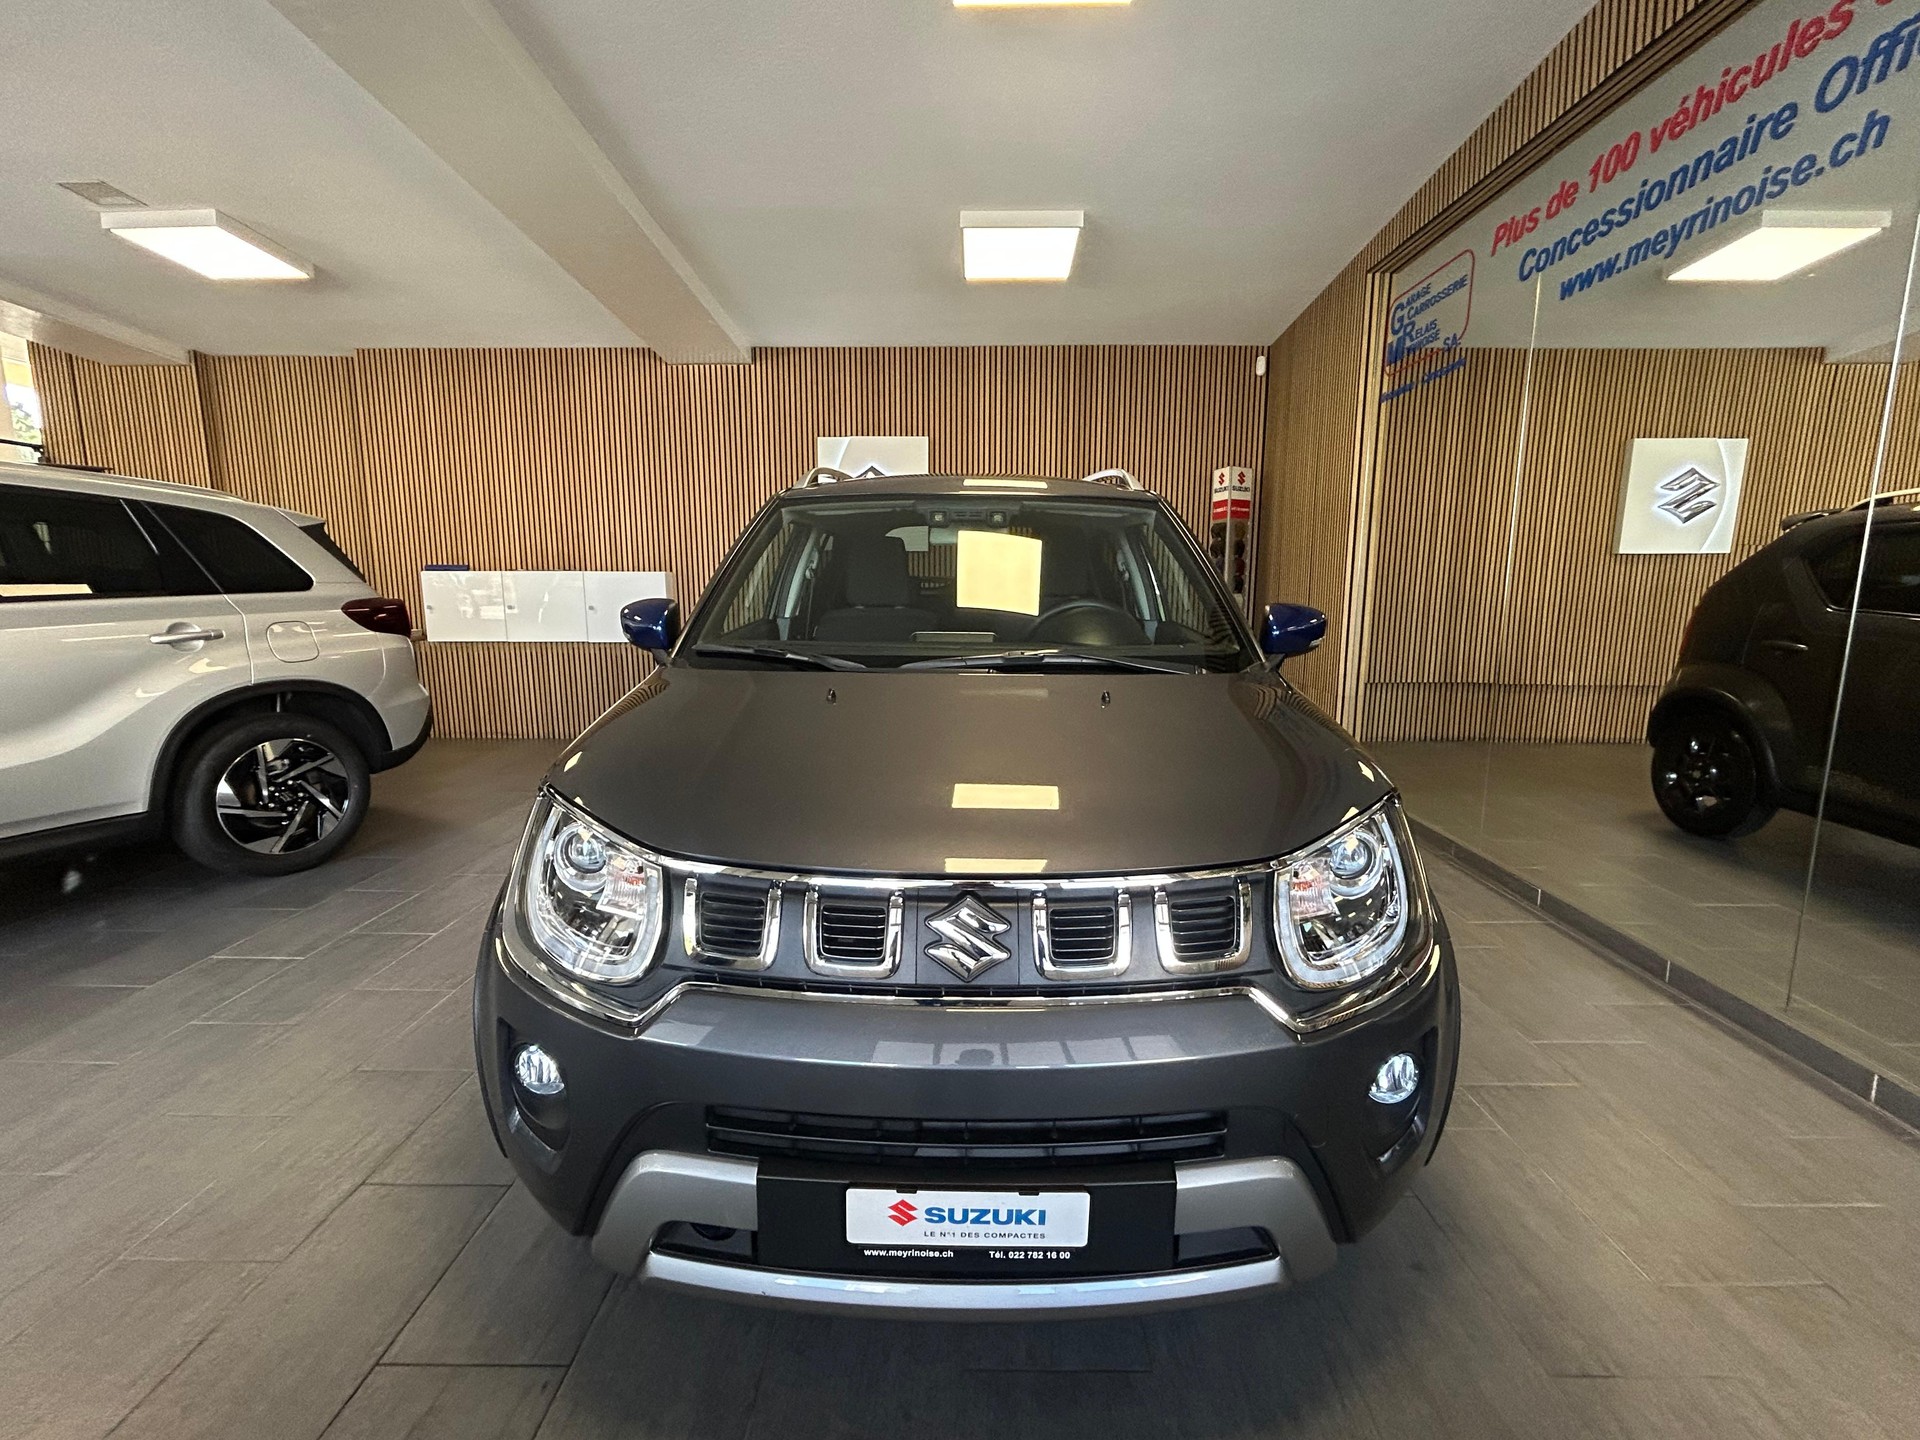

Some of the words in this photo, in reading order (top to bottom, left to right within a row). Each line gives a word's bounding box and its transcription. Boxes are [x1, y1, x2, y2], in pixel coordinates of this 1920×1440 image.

[1490, 207, 1541, 257] Plus
[1545, 181, 1579, 220] de
[1589, 131, 1642, 194] 100
[1649, 0, 1854, 154] véhicules
[1518, 102, 1798, 282] Concessionnaire
[1814, 12, 1920, 114] Offi
[1559, 109, 1891, 300] www.meyrinoise.ch
[1407, 274, 1468, 320] CARROSSERIE
[924, 1206, 1047, 1226] SUZUKI
[983, 1232, 1046, 1240] COMPACTES
[863, 1249, 954, 1259] www.meyrinoise.ch
[988, 1250, 1006, 1259] Tél.
[1008, 1251, 1025, 1259] 022
[1027, 1251, 1044, 1260] 782
[1046, 1251, 1057, 1260] 16
[1059, 1251, 1071, 1260] 00
